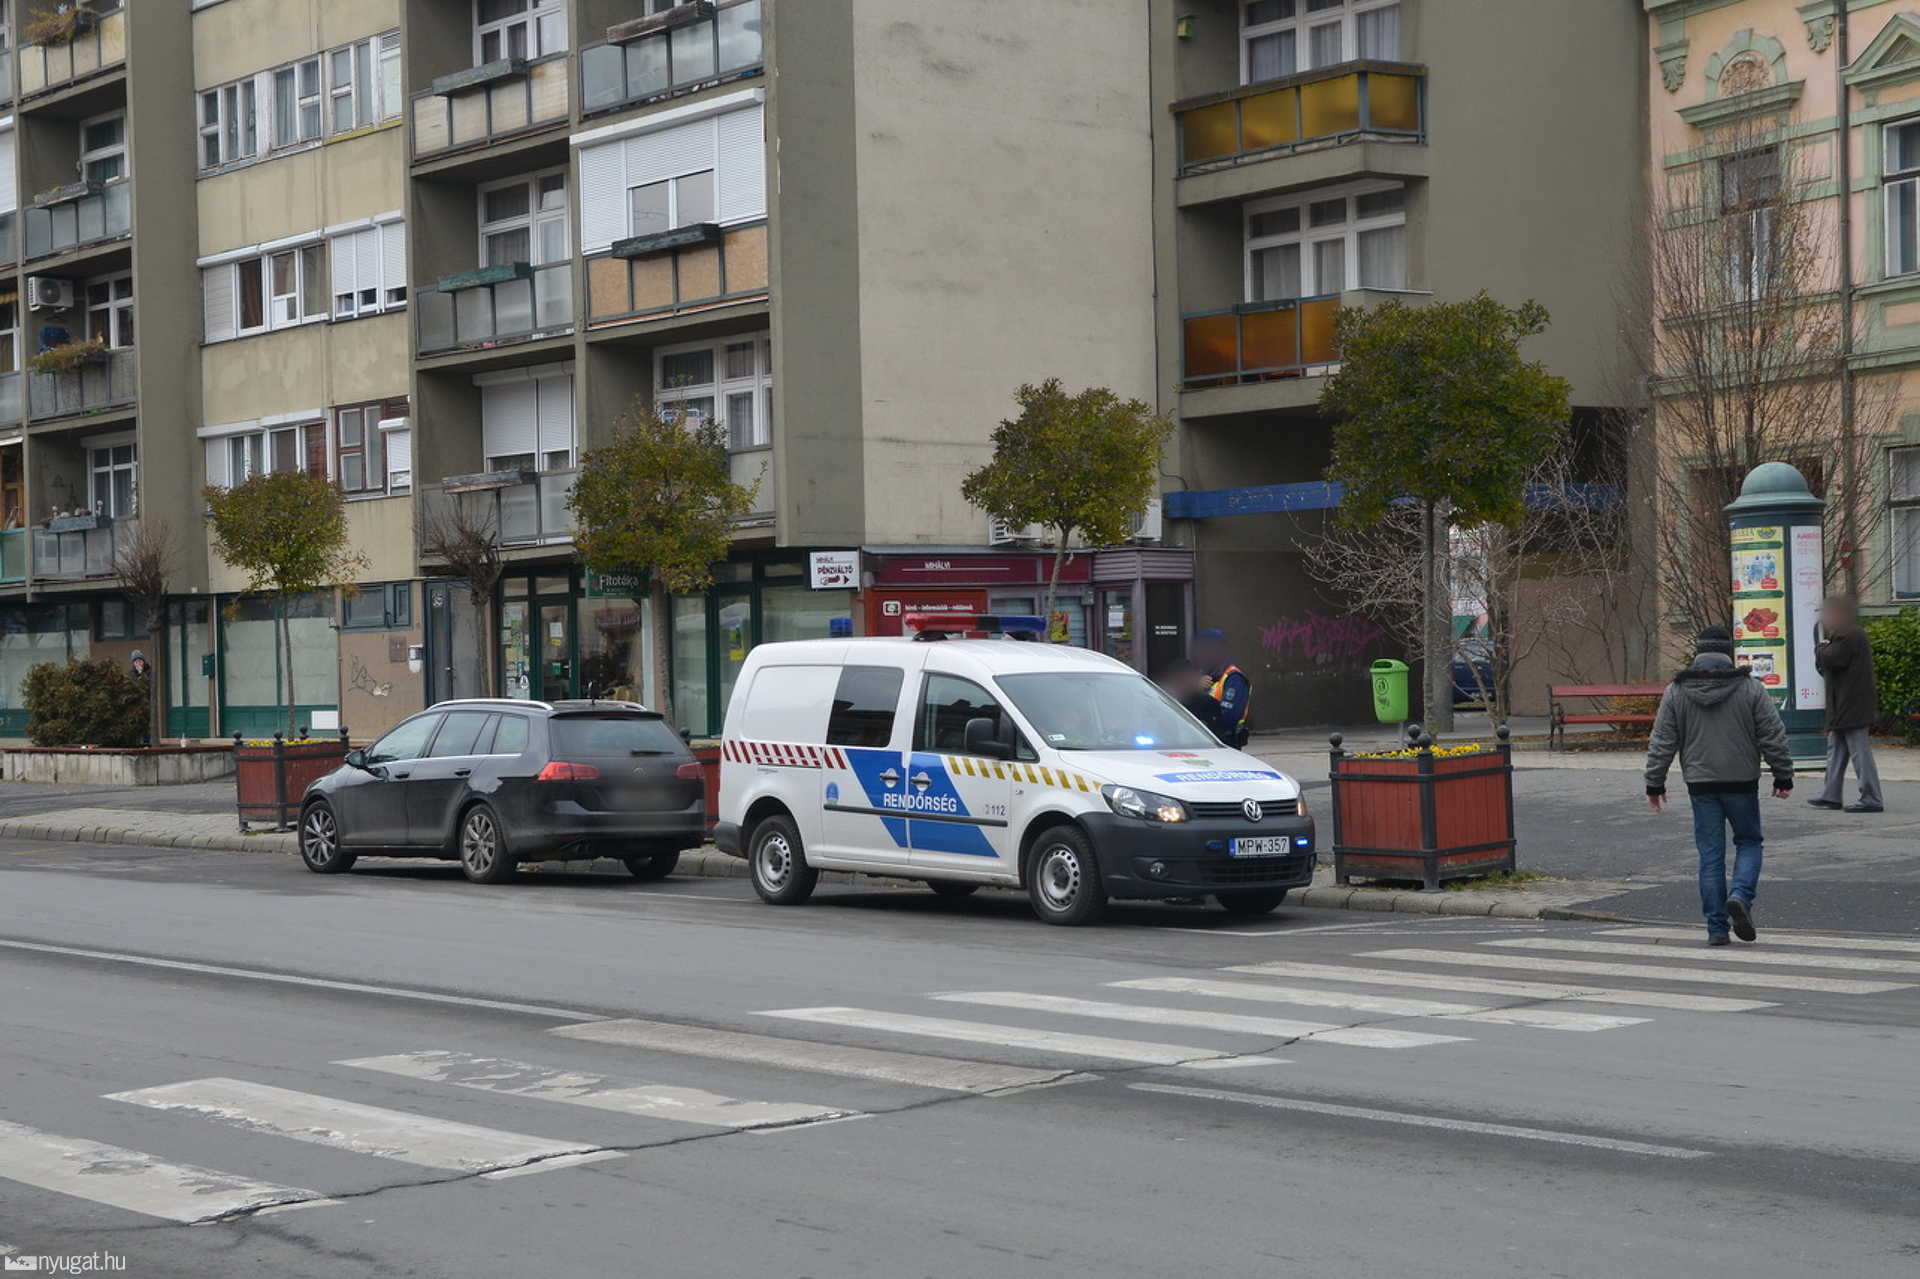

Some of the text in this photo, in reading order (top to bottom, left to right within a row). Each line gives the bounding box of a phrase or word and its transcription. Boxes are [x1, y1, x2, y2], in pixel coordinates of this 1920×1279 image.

[884, 793, 957, 812] RENDŐRSÉG
[991, 804, 1006, 816] 112
[1237, 838, 1287, 855] MPW-357
